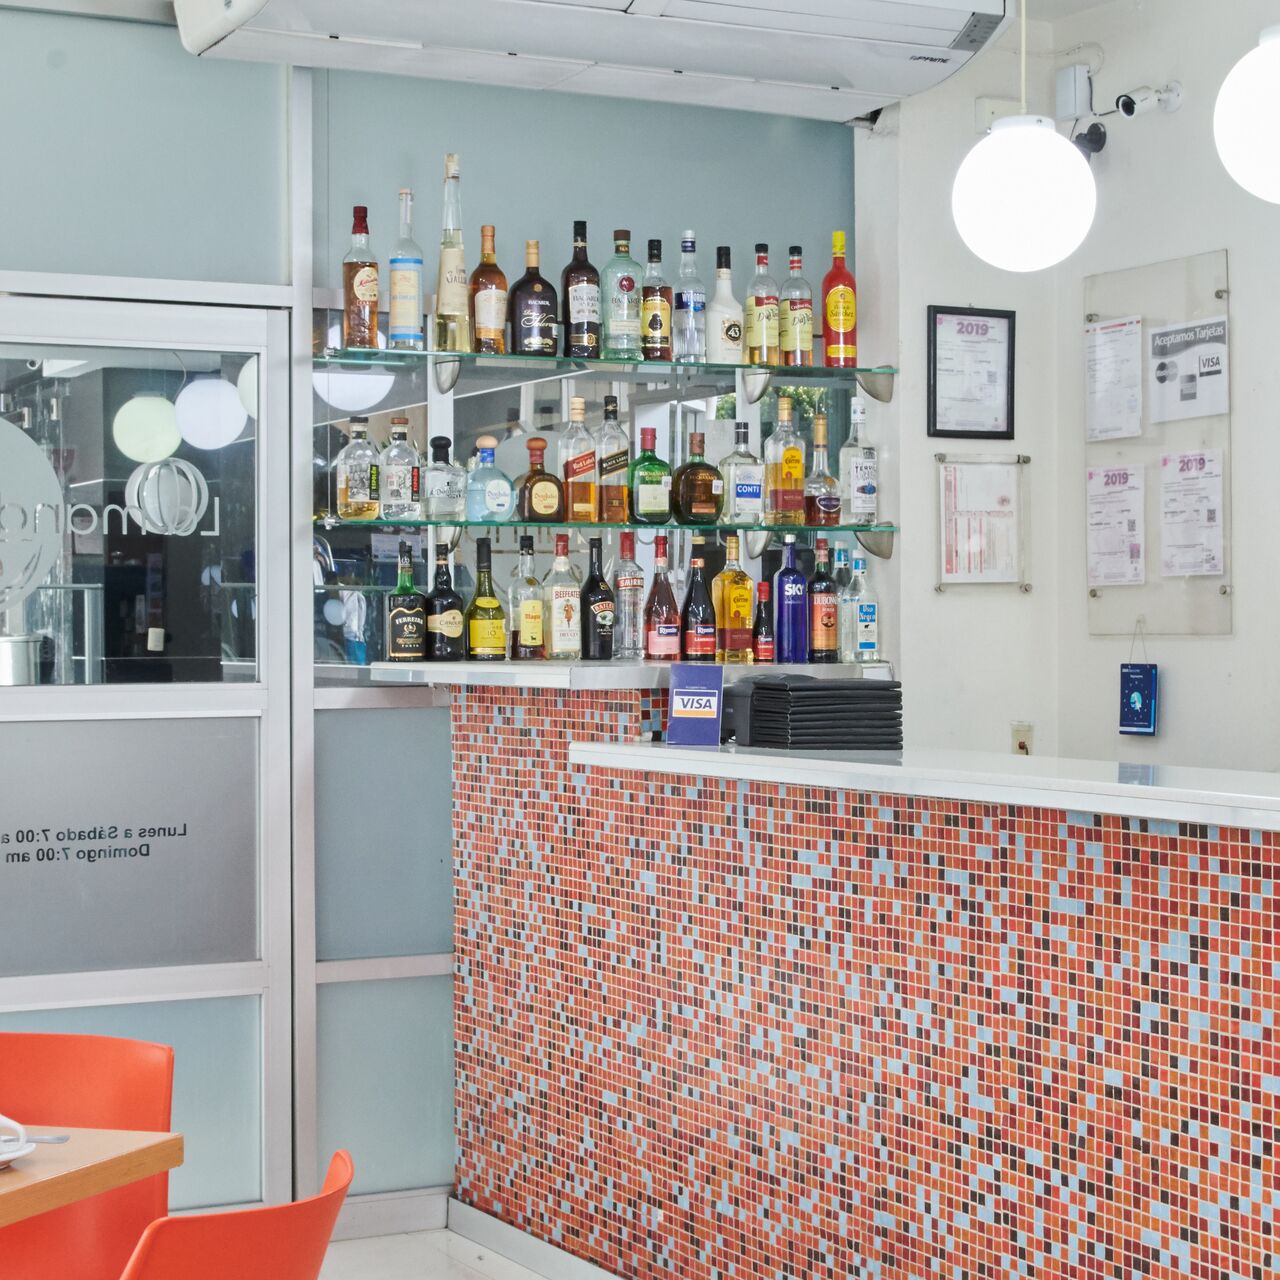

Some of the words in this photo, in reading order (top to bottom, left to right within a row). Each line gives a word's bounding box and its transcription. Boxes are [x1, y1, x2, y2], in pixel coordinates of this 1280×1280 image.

[727, 327, 741, 338] 43
[956, 322, 989, 336] 2019
[1154, 331, 1195, 348] Aceptamos
[1194, 325, 1224, 340] Tarjetas
[1201, 356, 1221, 369] VISA
[572, 461, 582, 469] Red
[1179, 457, 1206, 473] 2019
[1103, 472, 1129, 486] 2019
[737, 485, 760, 493] CONTI
[554, 590, 581, 599] BEEFEATE
[680, 697, 712, 709] VISA
